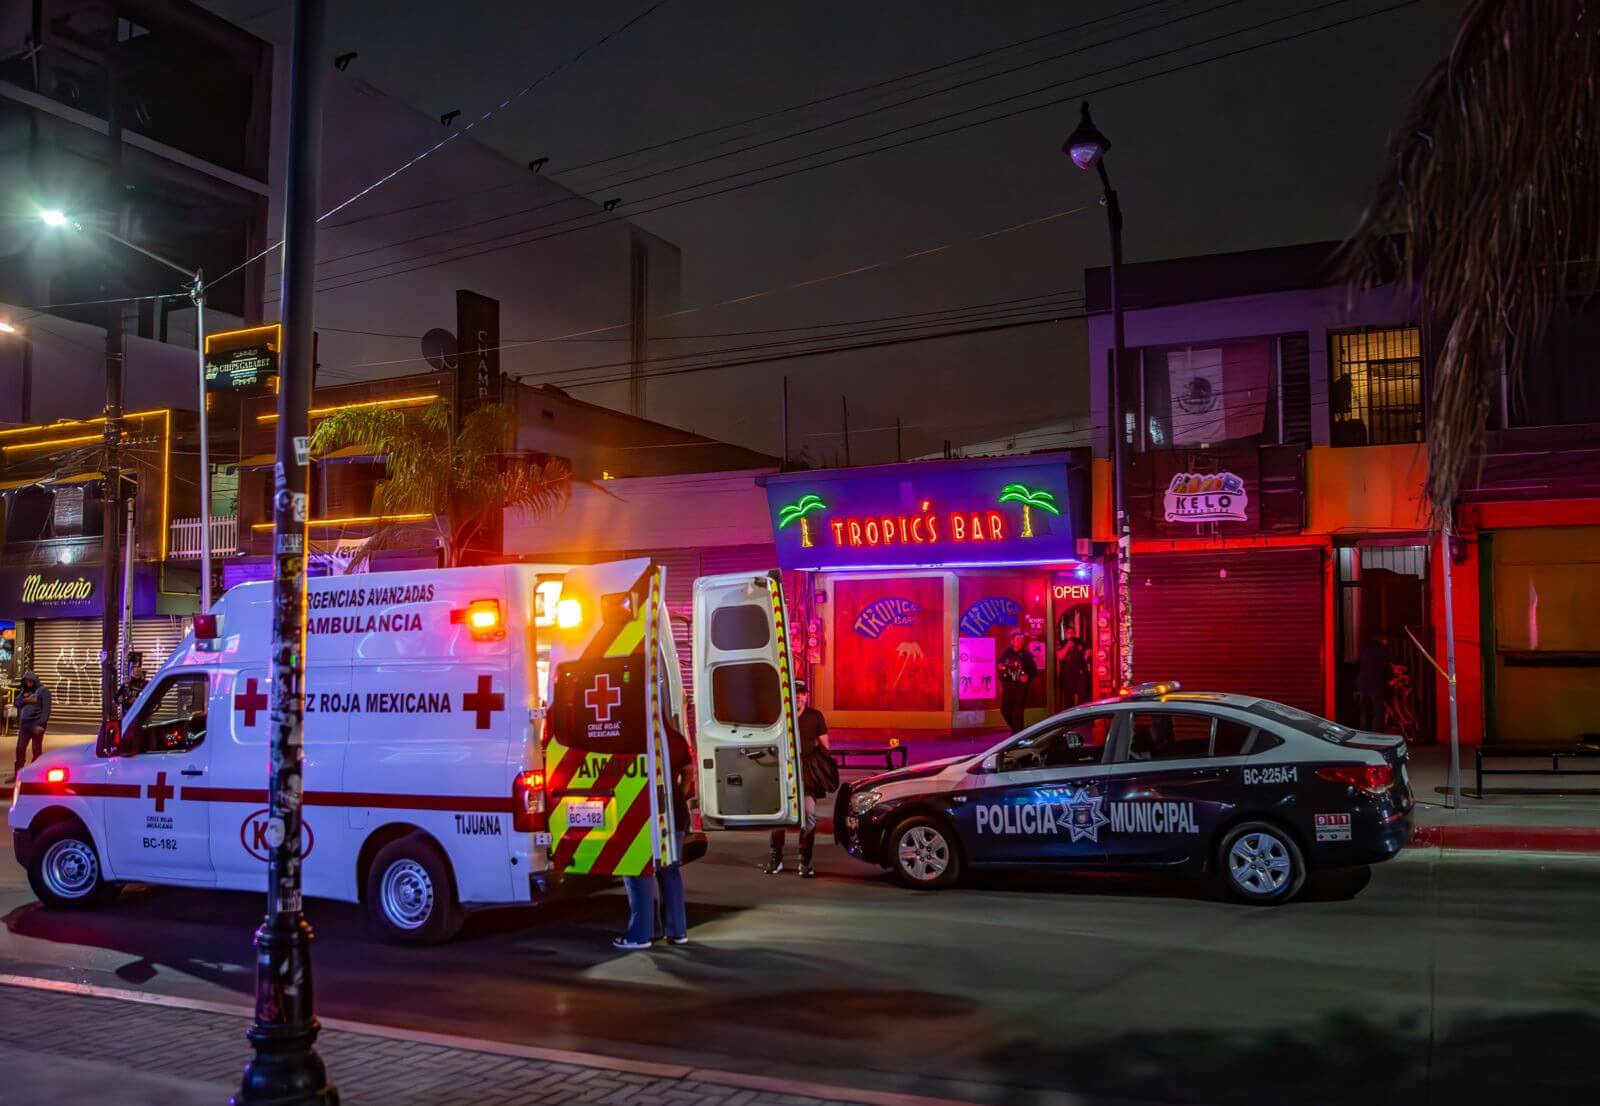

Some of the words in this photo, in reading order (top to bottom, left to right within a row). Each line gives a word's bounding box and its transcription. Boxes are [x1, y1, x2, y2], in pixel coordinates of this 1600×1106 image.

[1176, 495, 1231, 509] KELO
[831, 500, 938, 546] TROPIC'S
[952, 512, 1005, 541] BAR
[22, 574, 92, 603] Madueño
[366, 584, 435, 606] AVANZADAS
[1055, 585, 1089, 599] OPEN
[306, 613, 422, 635] AMBULANCIA
[320, 693, 361, 713] ROJA
[366, 693, 451, 713] MEXICANA
[455, 815, 502, 835] TIJUANA
[570, 813, 602, 824] BC-182
[1110, 801, 1199, 833] MUNICIPAL
[1318, 815, 1347, 825] 911
[143, 837, 177, 850] BC-182
